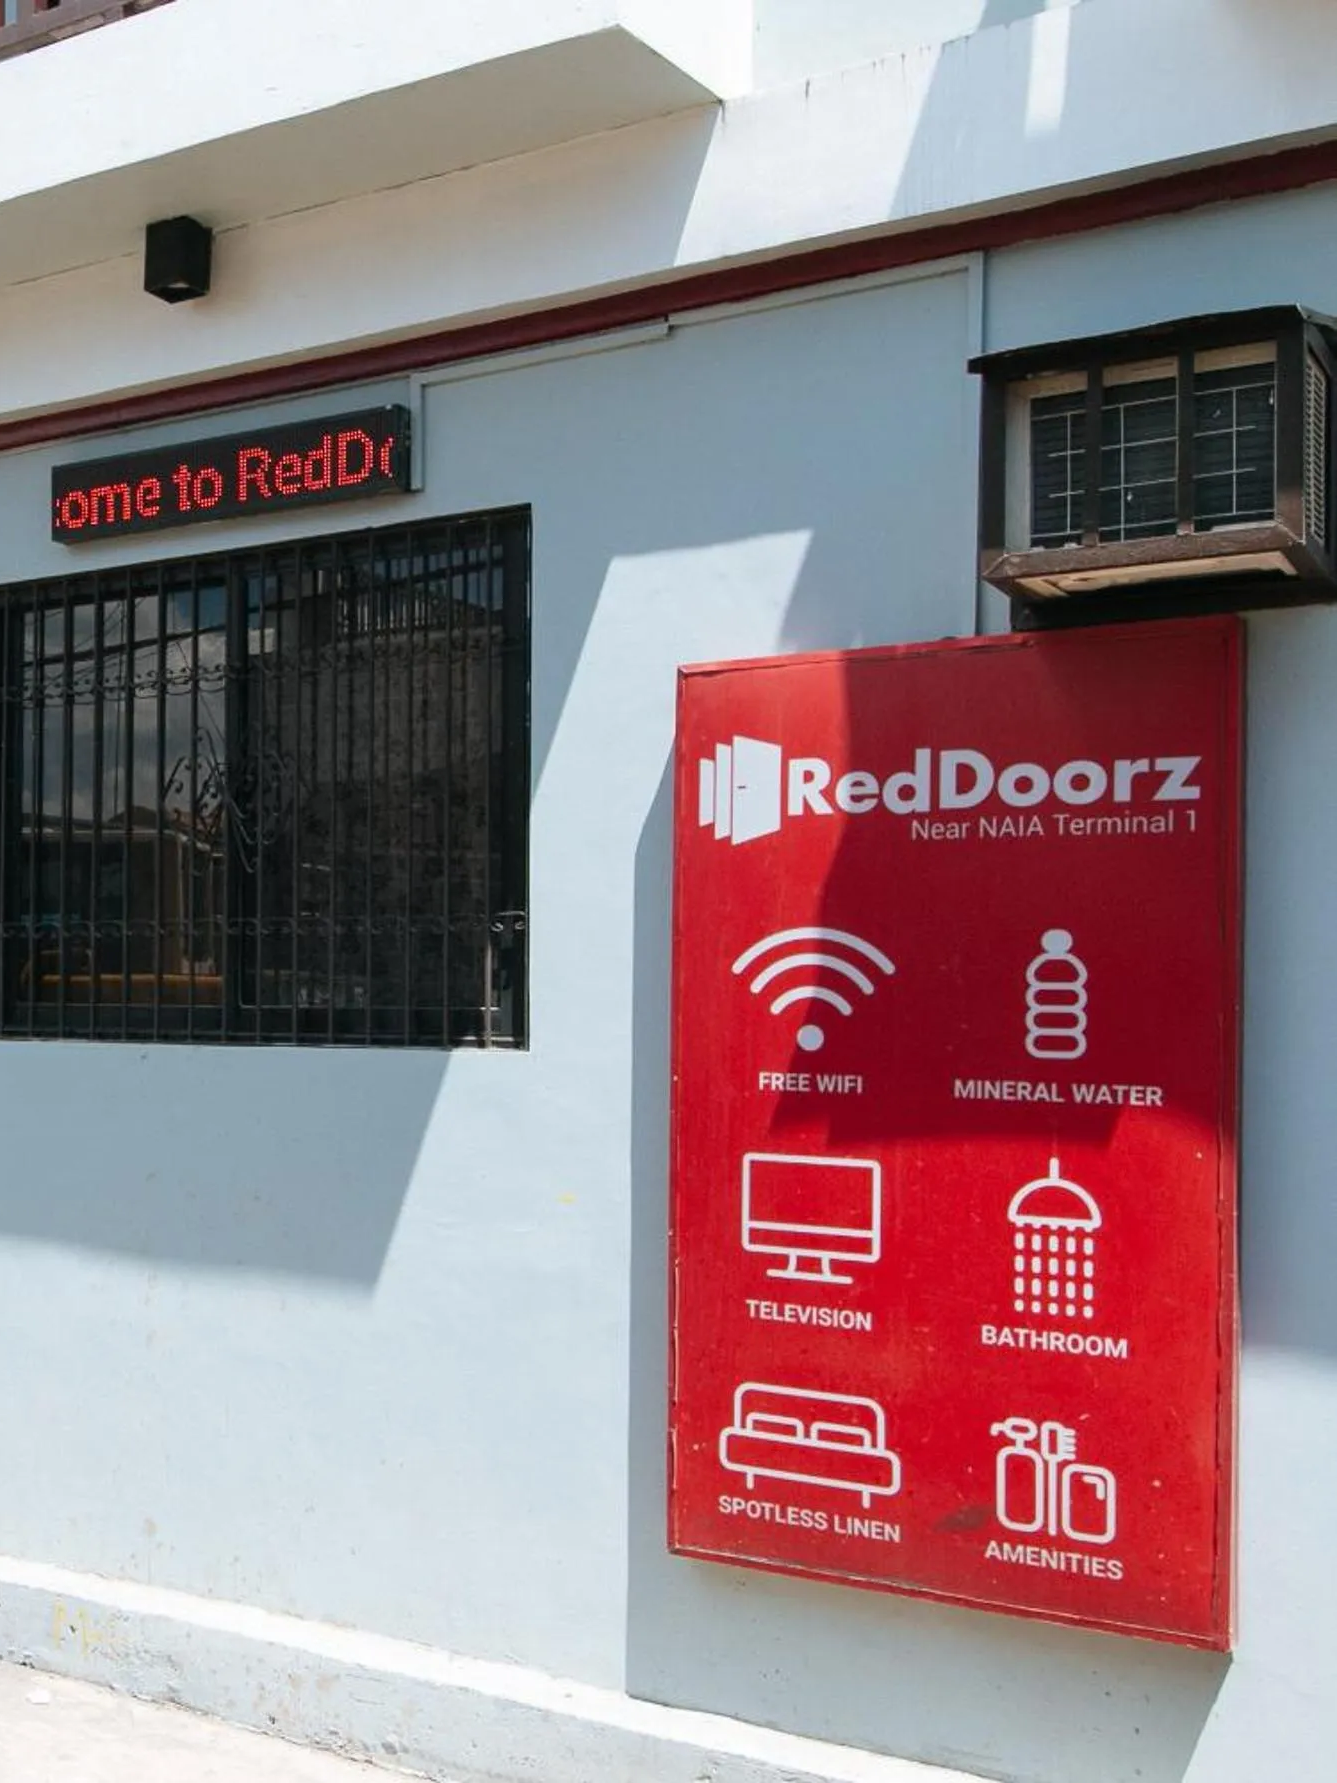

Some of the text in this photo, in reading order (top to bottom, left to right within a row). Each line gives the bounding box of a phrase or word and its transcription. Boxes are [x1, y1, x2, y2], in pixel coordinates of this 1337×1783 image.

[55, 477, 161, 529] ome
[171, 464, 224, 512] to
[786, 747, 1202, 817] RedDoorz
[911, 809, 1197, 841] Near NAIA Terminal 1
[757, 1071, 864, 1094] FREE WIFI
[953, 1078, 1163, 1107] MINERAL WATER
[745, 1298, 873, 1332] TELEVISION
[980, 1324, 1129, 1359] BATHROOM
[718, 1495, 902, 1543] SPOTLESS LINEN
[983, 1540, 1124, 1581] AMENITIES
